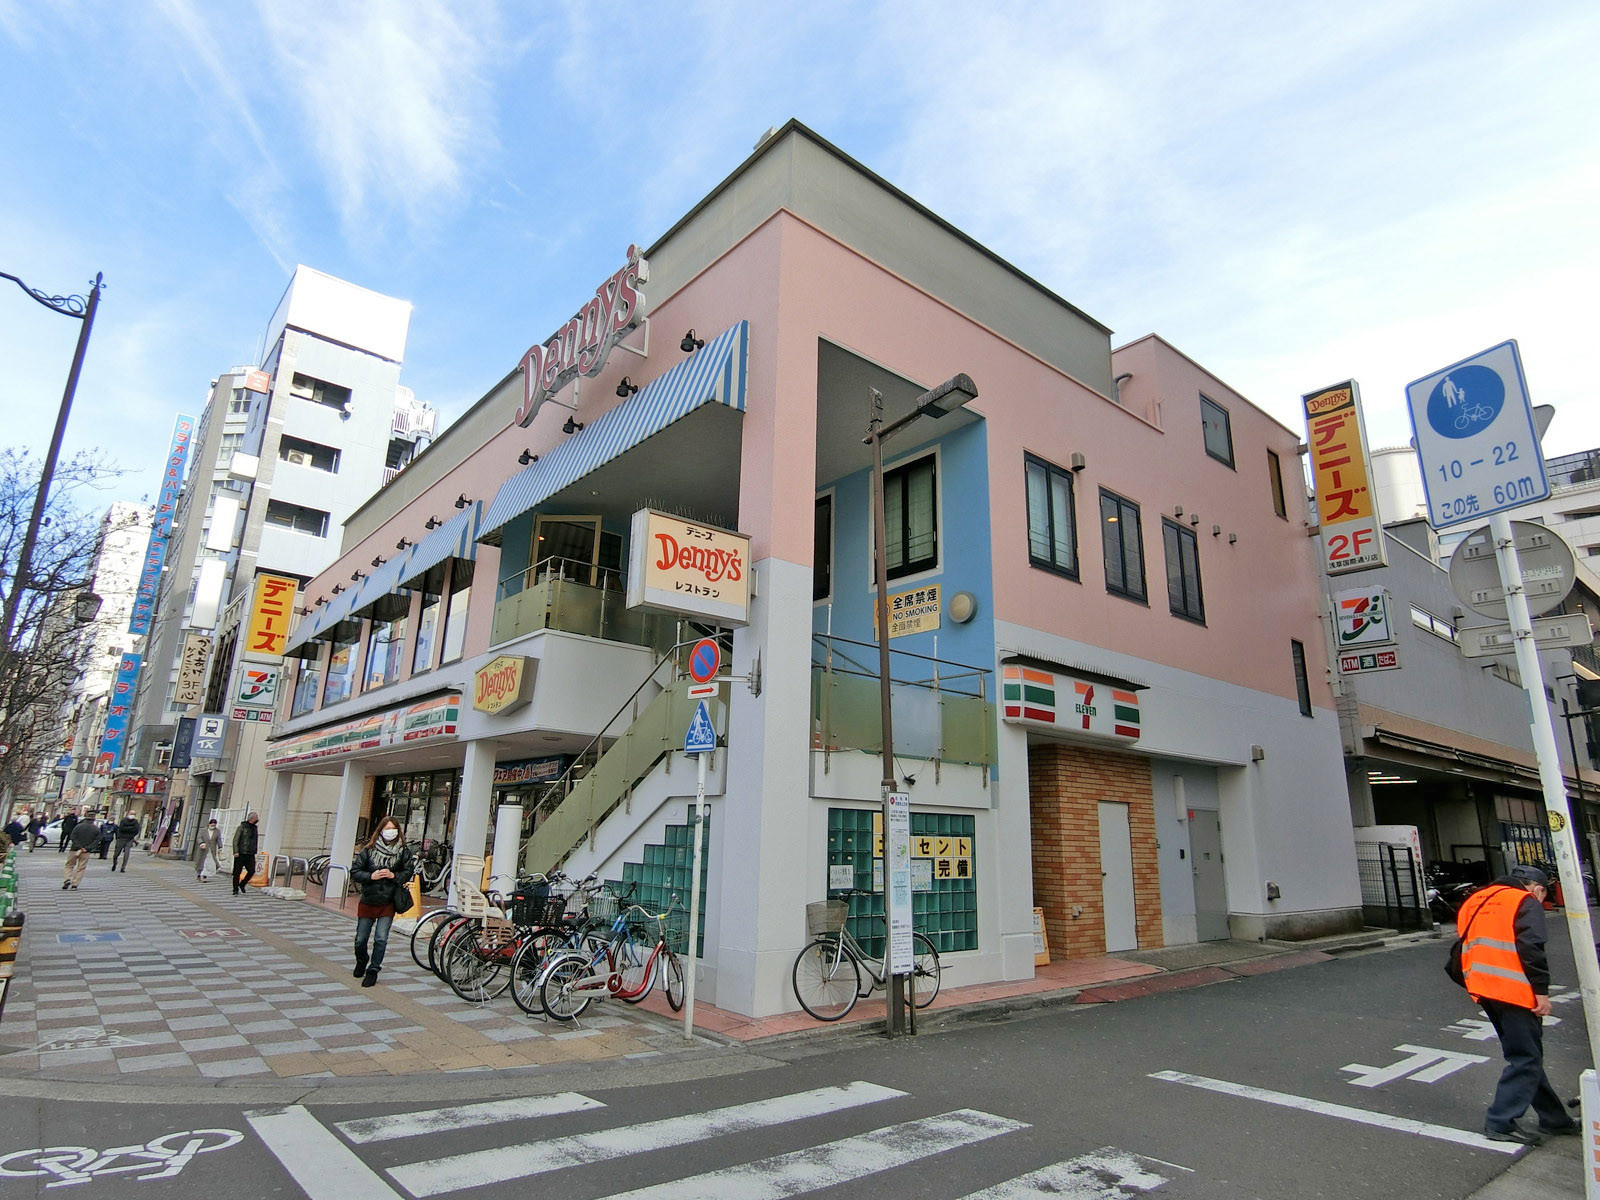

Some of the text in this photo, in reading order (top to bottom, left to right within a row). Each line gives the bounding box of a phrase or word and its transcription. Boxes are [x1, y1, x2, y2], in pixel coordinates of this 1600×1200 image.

[514, 243, 649, 428] Denny's
[1310, 390, 1347, 412] Denny's
[1313, 410, 1367, 521] デニーズ
[1441, 476, 1536, 520] この先 60m
[685, 526, 716, 542] デニーズ
[1327, 528, 1373, 562] 2F
[654, 533, 742, 583] Denny's
[675, 581, 721, 599] レストラン
[893, 587, 938, 611] 全席禁煙
[252, 579, 296, 652] デニーズ
[893, 603, 938, 621] NO SMOKING
[192, 638, 211, 677] からあげ
[1343, 658, 1359, 670] ATM
[181, 681, 201, 690] 3F
[477, 660, 518, 704] Denny's
[260, 713, 272, 721] ATM
[938, 859, 968, 877] 完備
